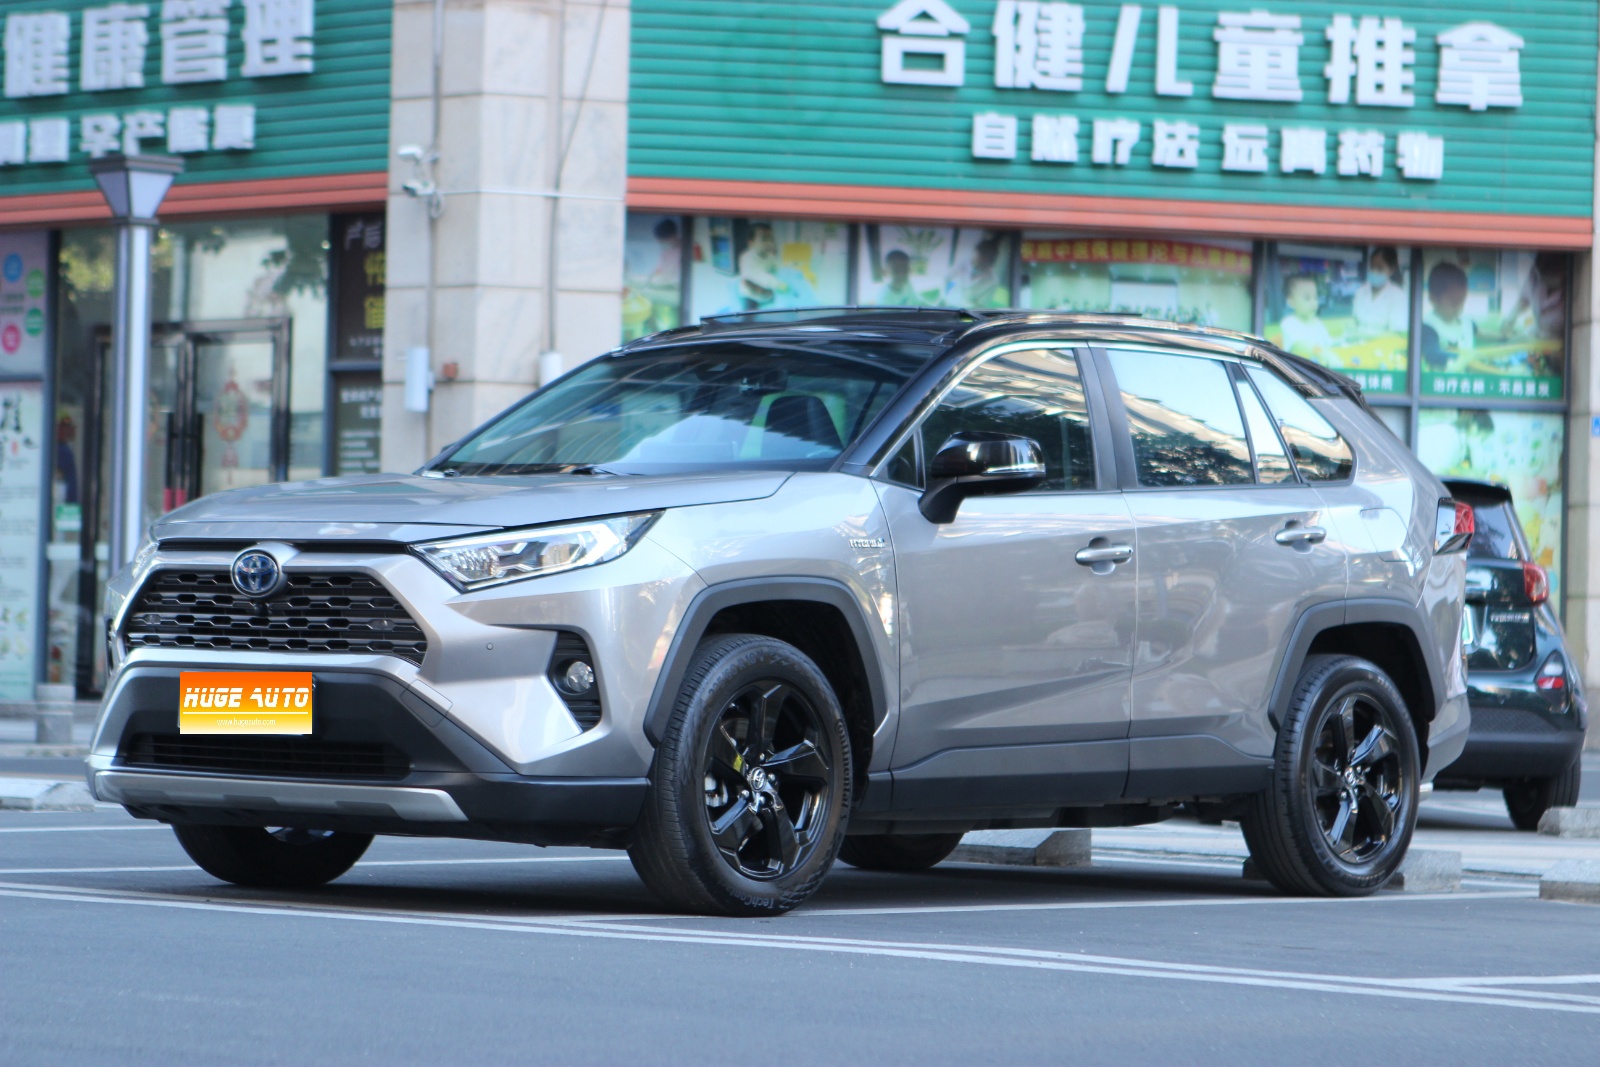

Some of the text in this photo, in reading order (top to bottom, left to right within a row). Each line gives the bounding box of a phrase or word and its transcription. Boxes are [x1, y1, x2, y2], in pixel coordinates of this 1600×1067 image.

[4, 0, 315, 98] 健康管理
[877, 0, 1524, 110] 合健儿童推拿
